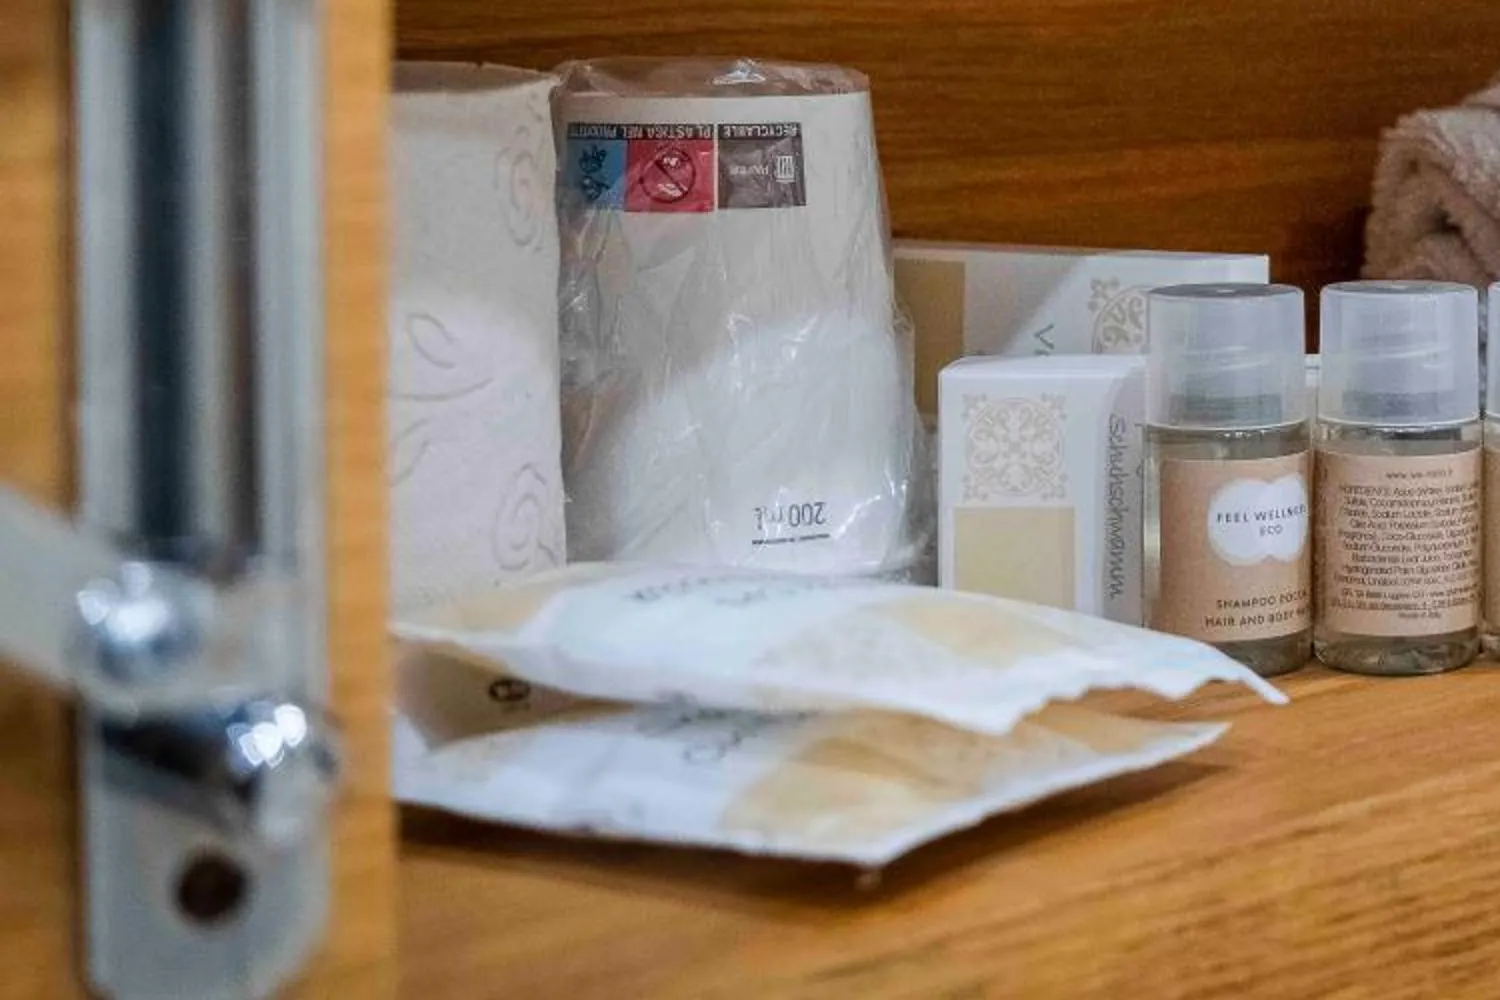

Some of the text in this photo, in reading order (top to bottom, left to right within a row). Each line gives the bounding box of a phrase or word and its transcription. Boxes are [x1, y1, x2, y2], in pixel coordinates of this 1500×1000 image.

[786, 501, 827, 528] 200
[1217, 511, 1249, 523] FEEL
[1259, 524, 1283, 537] ECO
[1217, 596, 1276, 609] SHAMPOO
[1204, 615, 1235, 627] HAIR
[1239, 615, 1265, 626] AND
